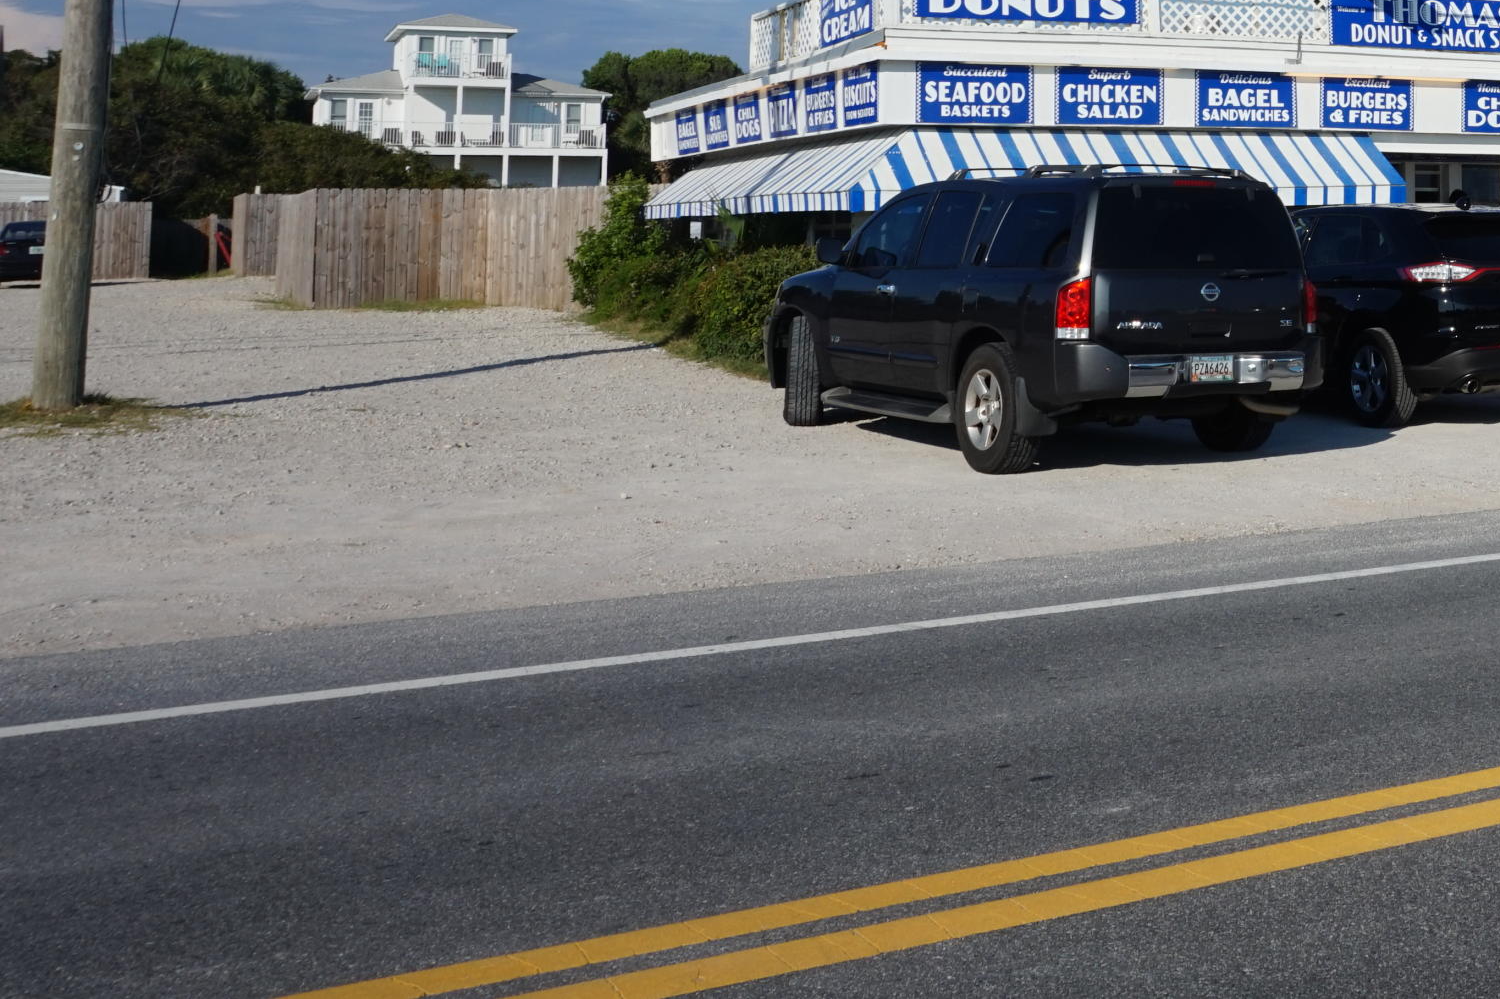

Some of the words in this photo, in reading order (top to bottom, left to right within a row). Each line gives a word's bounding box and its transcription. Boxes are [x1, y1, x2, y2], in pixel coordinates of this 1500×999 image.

[822, 4, 870, 43] CREAM
[1351, 23, 1414, 45] DONUT
[1418, 30, 1428, 43] &
[1432, 26, 1487, 48] SNACK
[943, 65, 1008, 78] Succulent
[1088, 69, 1131, 82] Superb
[1219, 73, 1273, 85] Delicious
[924, 81, 1026, 103] SEAFOOD
[1345, 78, 1391, 89] Excellent
[806, 90, 835, 111] BURGERS
[844, 80, 876, 107] BISCUITS
[1062, 83, 1157, 104] CHICKEN
[1208, 88, 1285, 107] BAGEL
[1326, 90, 1408, 110] BURGERS
[737, 105, 756, 120] CHILI
[769, 97, 797, 133] PIZZA
[808, 112, 814, 127] &
[815, 109, 834, 125] FRIES
[940, 105, 1010, 118] BASKETS
[1077, 104, 1143, 119] SALAD
[1202, 108, 1290, 123] SANDWICHES
[1329, 109, 1345, 123] &
[1348, 110, 1404, 125] FRIES
[678, 122, 697, 139] BAGEL
[709, 115, 722, 132] SUB
[736, 119, 760, 139] DOGS
[1280, 319, 1293, 327] SE
[1194, 363, 1229, 376] PZA6426
